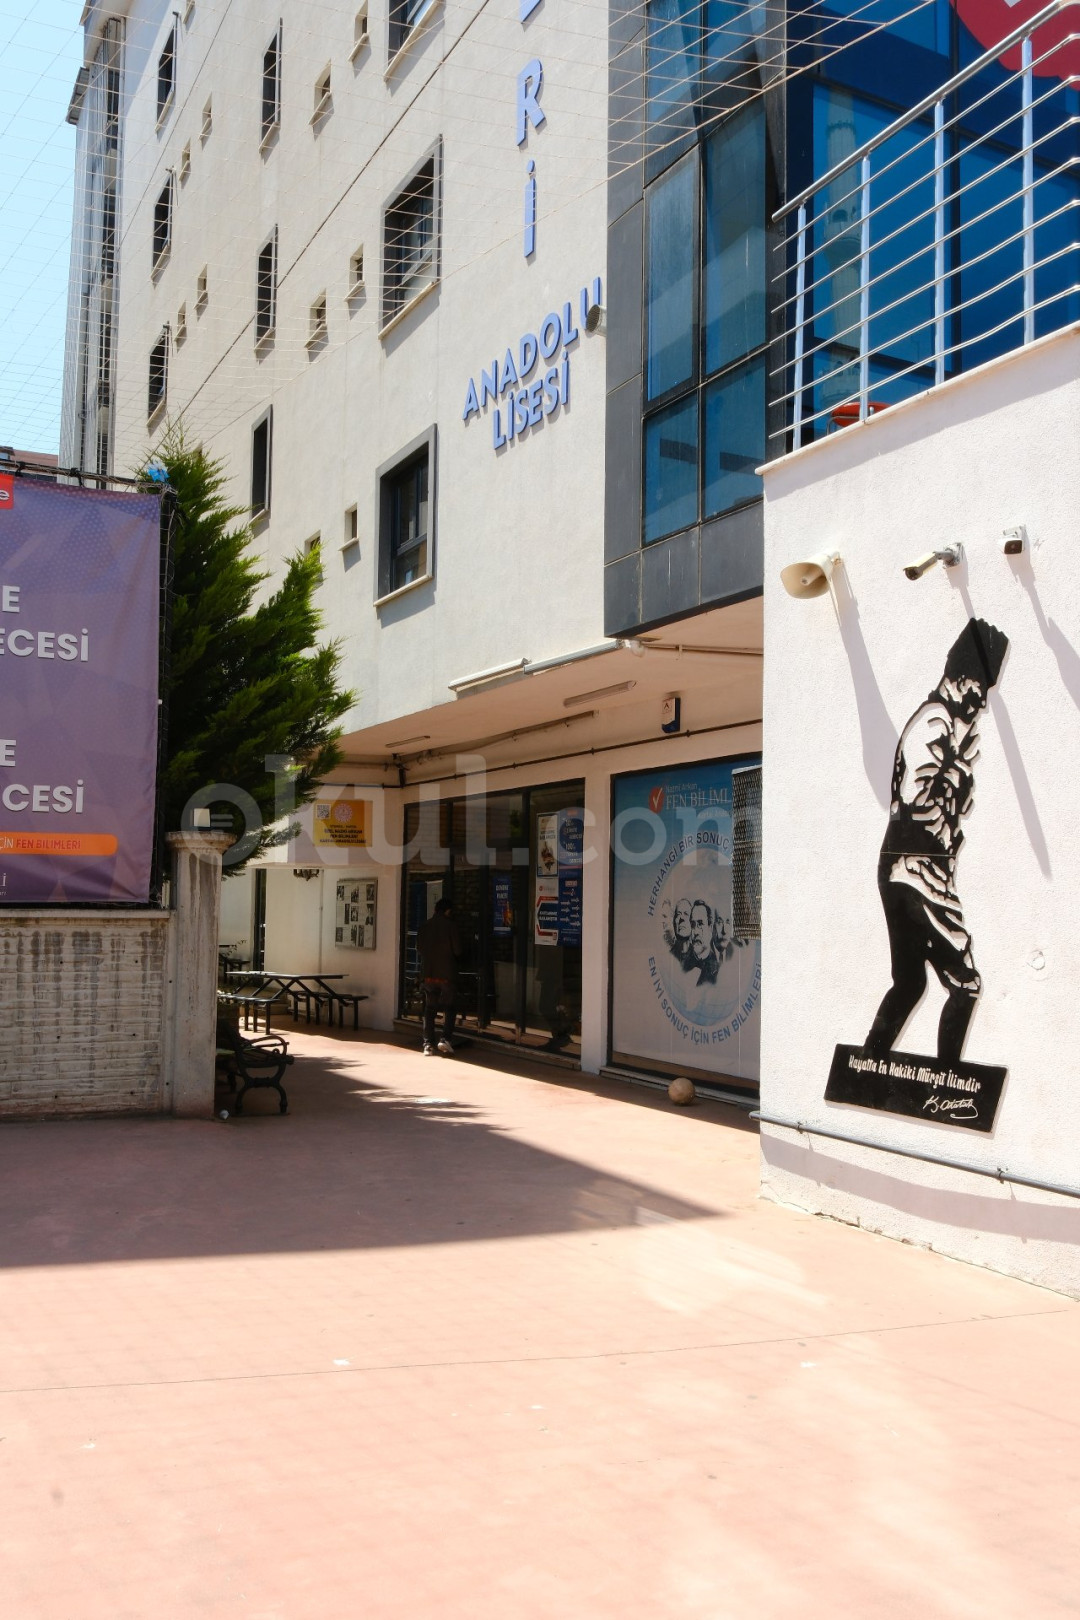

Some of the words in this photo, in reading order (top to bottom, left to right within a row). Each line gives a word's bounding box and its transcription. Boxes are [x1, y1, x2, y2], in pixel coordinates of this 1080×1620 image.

[462, 276, 602, 421] ANADOLU
[492, 349, 570, 450] LİSESİ
[666, 794, 687, 810] FEN
[16, 839, 34, 849] FEN
[648, 844, 679, 917] HERHANGİ
[678, 834, 695, 854] BİR
[648, 956, 657, 977] EN
[661, 998, 689, 1040] SONUÇ
[690, 1025, 710, 1046] İÇİN
[711, 1025, 731, 1044] FEN
[848, 1054, 877, 1073] Hayatta
[878, 1059, 888, 1075] En
[889, 1061, 917, 1081] Hakiki
[946, 1069, 982, 1094] İlimdir
